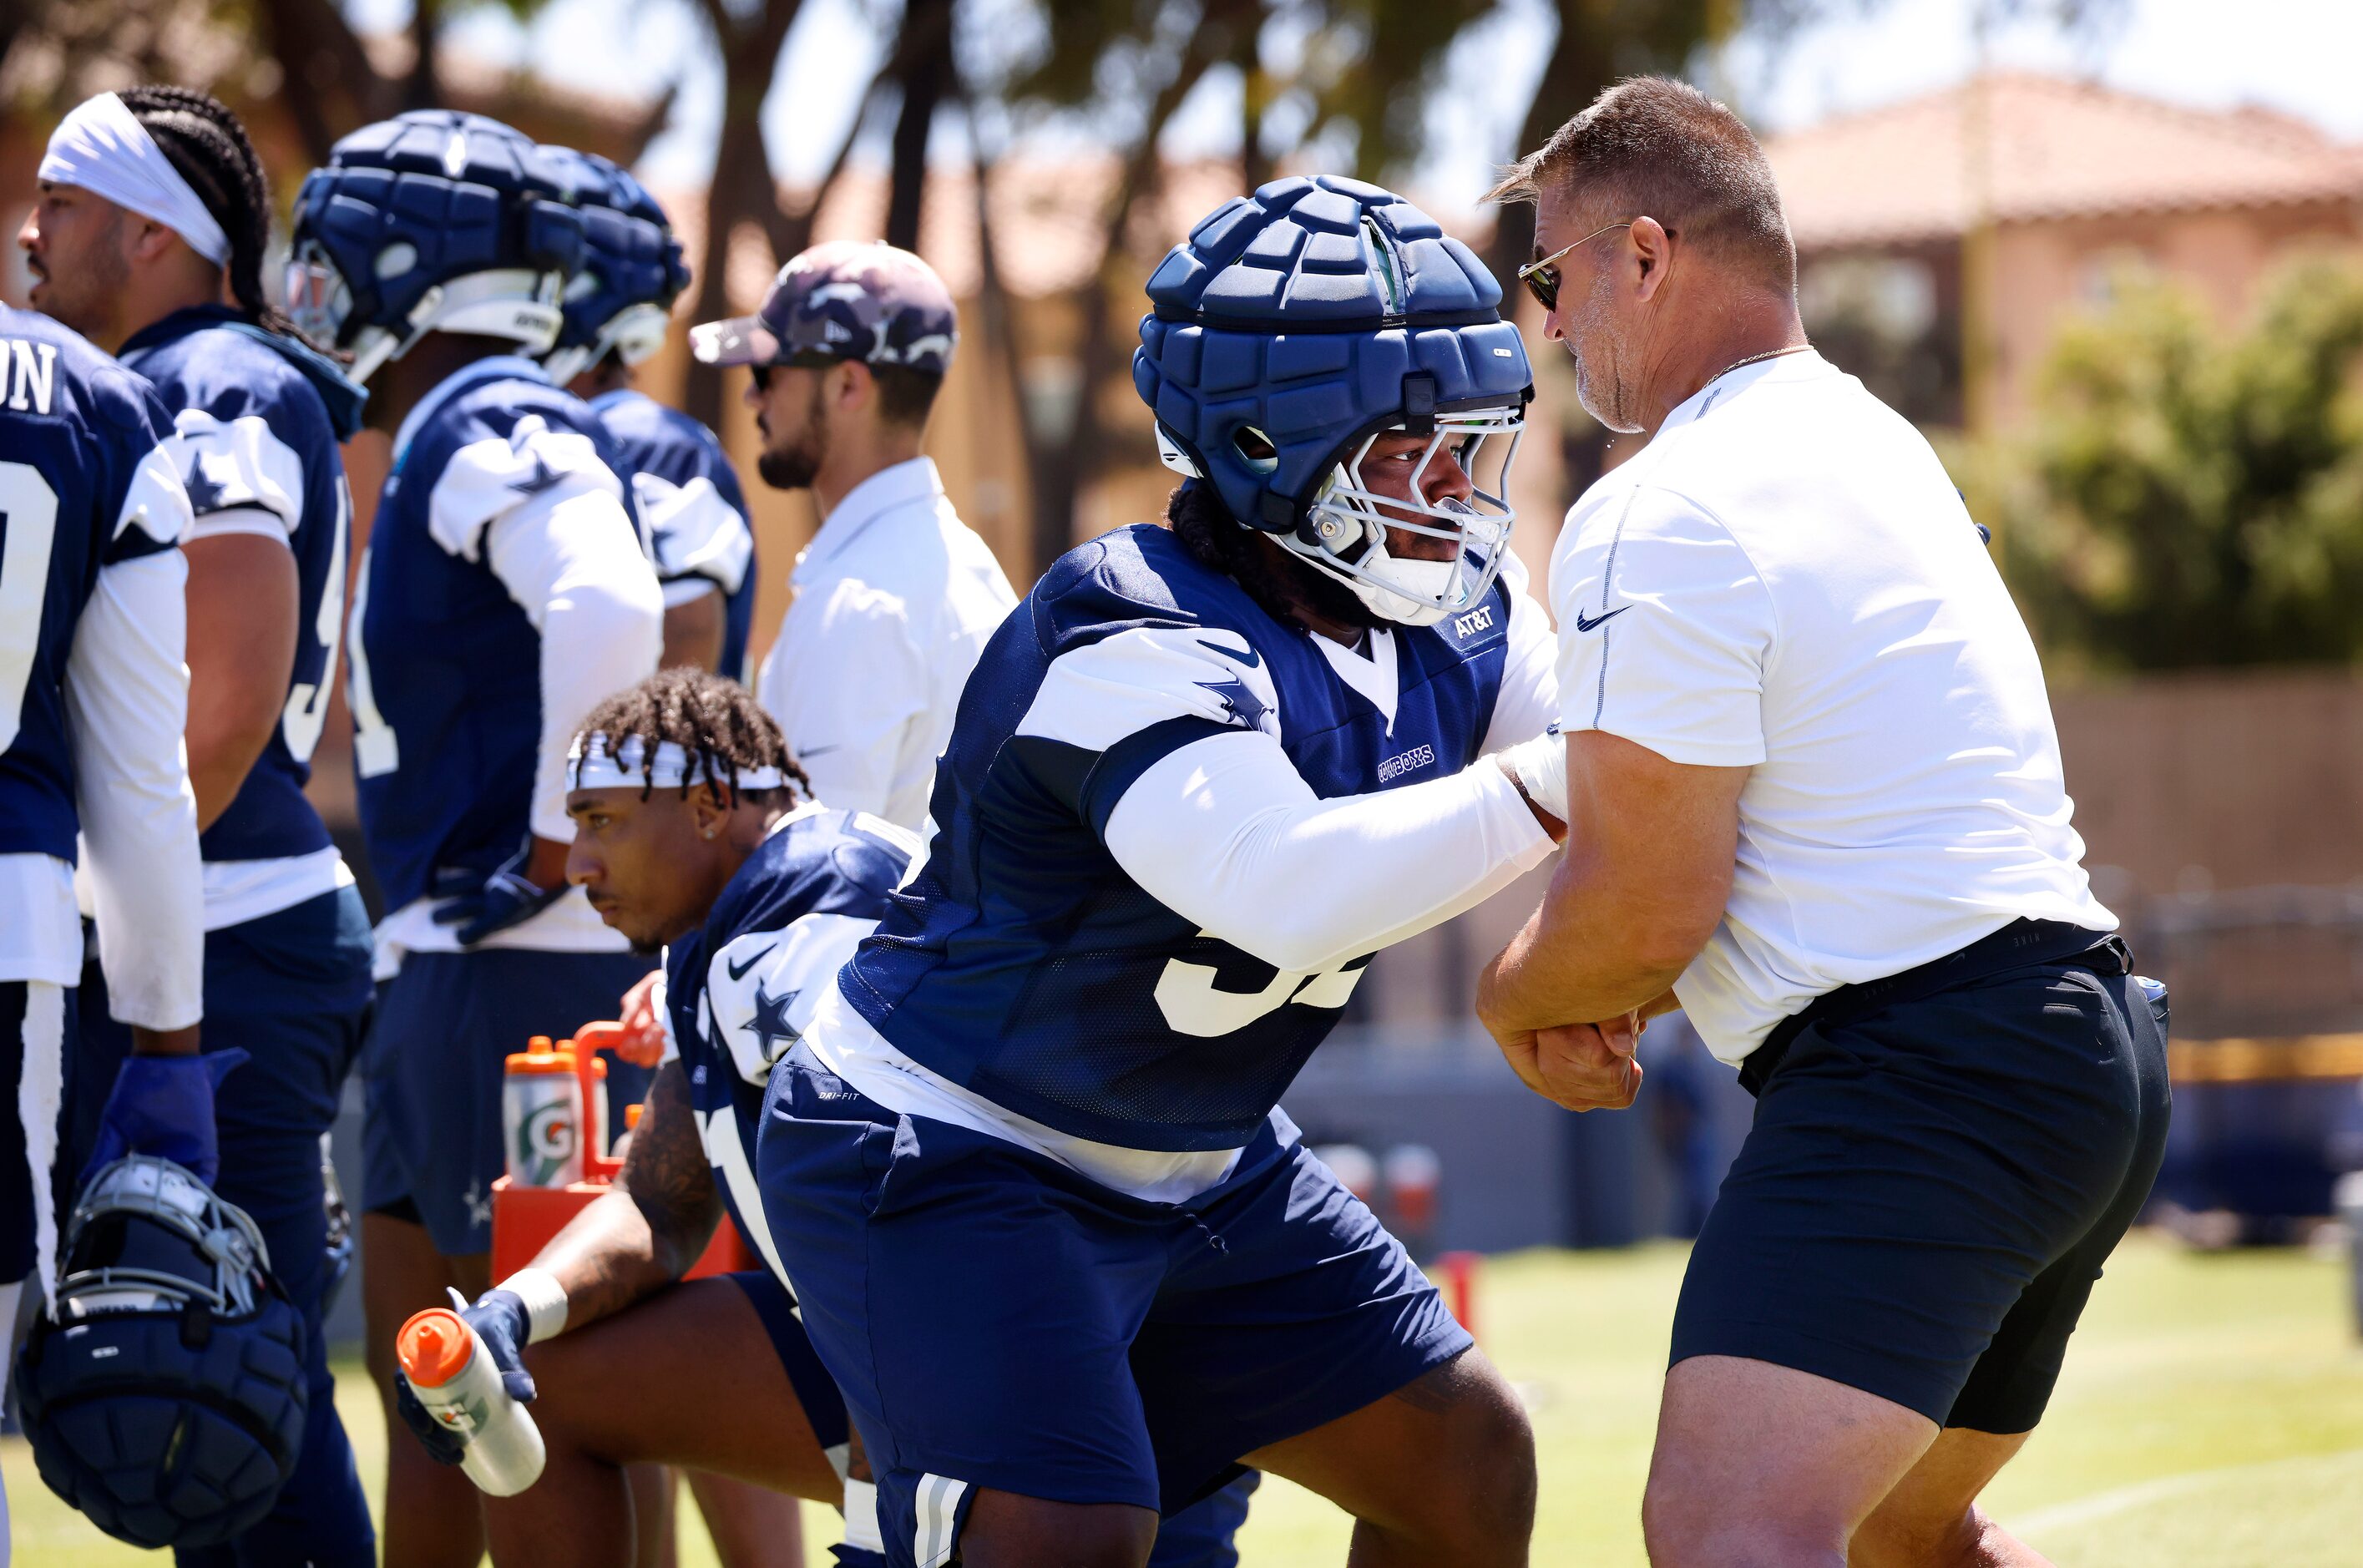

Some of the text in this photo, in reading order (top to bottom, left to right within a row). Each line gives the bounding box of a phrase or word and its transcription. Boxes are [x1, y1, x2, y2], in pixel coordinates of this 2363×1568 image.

[1455, 605, 1494, 639] AT&T
[1378, 744, 1434, 783] COWBOYS
[818, 1091, 860, 1100] DRI-FIT
[528, 1106, 574, 1160] G
